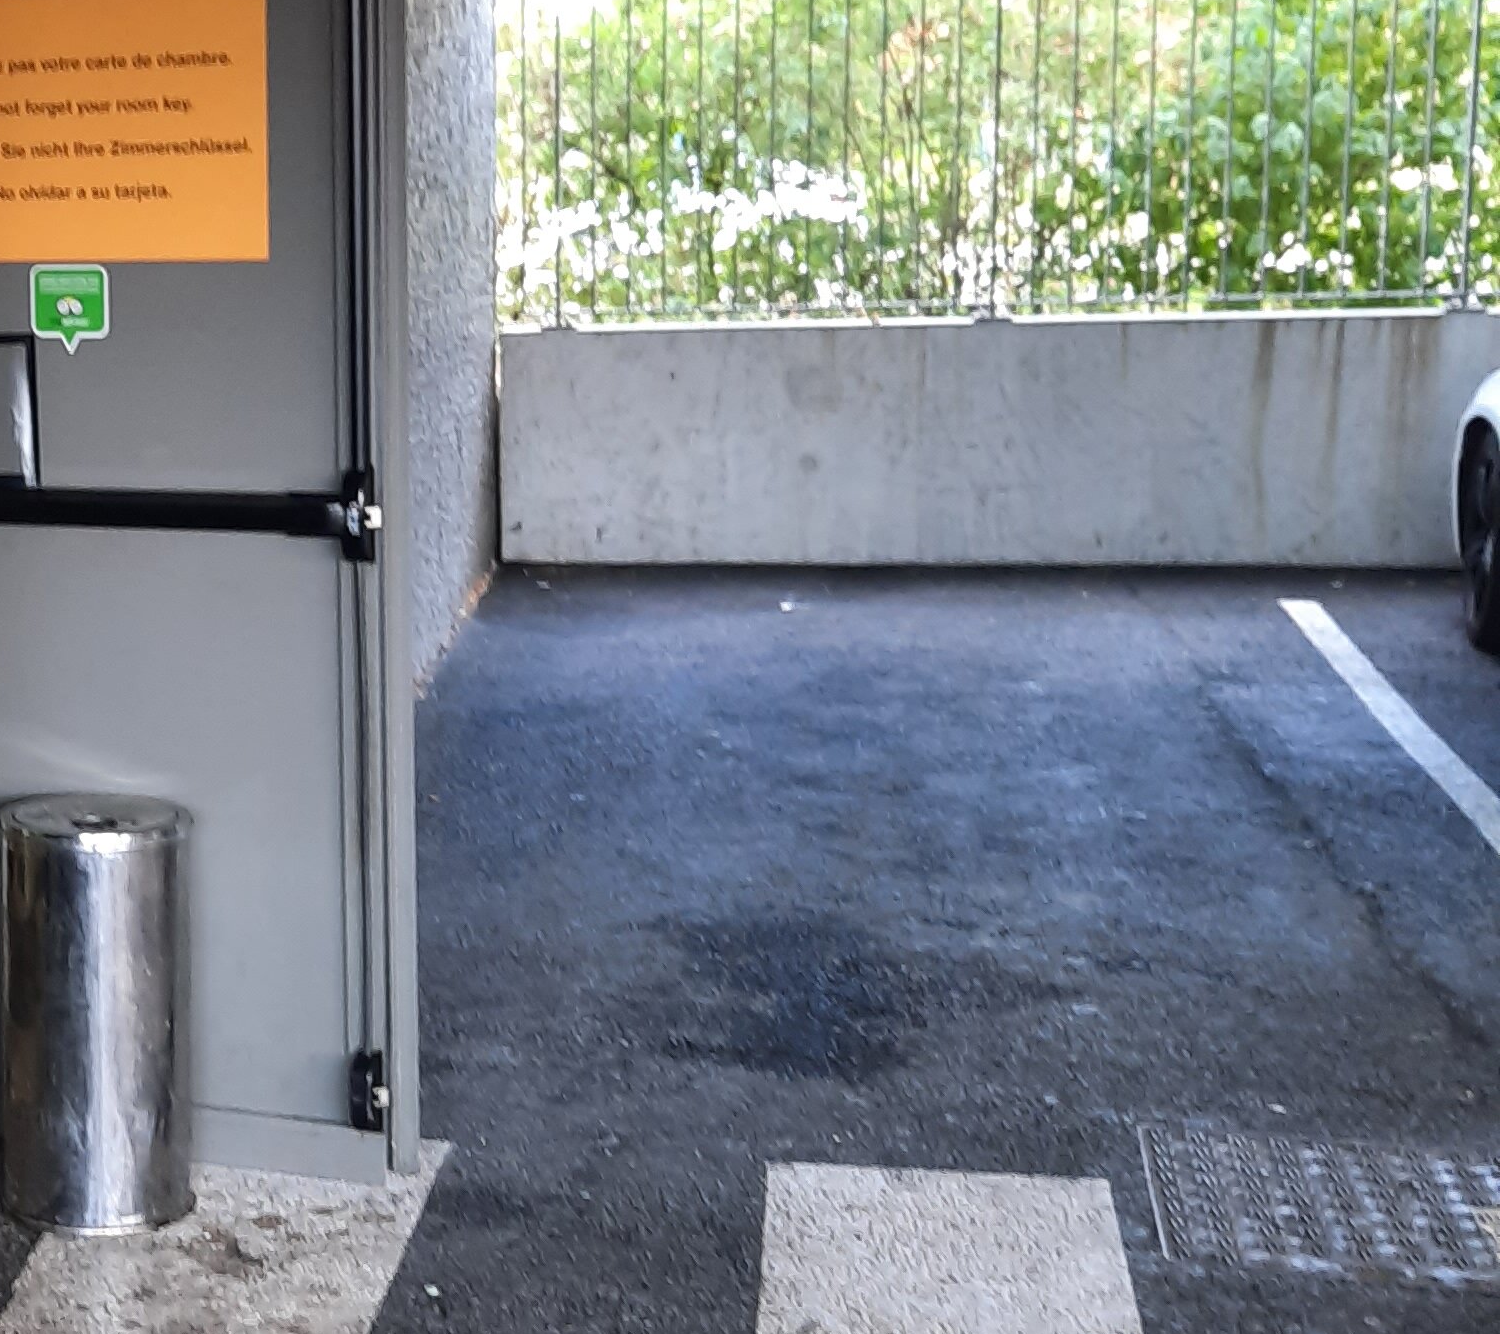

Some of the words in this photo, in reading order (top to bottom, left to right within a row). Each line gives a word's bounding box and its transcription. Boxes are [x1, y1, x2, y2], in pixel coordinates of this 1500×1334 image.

[8, 59, 36, 76] pas
[41, 56, 80, 72] votre
[85, 54, 127, 70] carte
[131, 52, 152, 68] de
[156, 50, 234, 68] chambre.
[25, 98, 73, 119] forget
[76, 100, 110, 118] your
[116, 98, 159, 113] room
[0, 141, 26, 159] Sie
[30, 140, 70, 158] nicht
[73, 140, 105, 157] Ihre
[19, 184, 71, 201] olvidar
[76, 186, 87, 200] a
[91, 185, 110, 200] su
